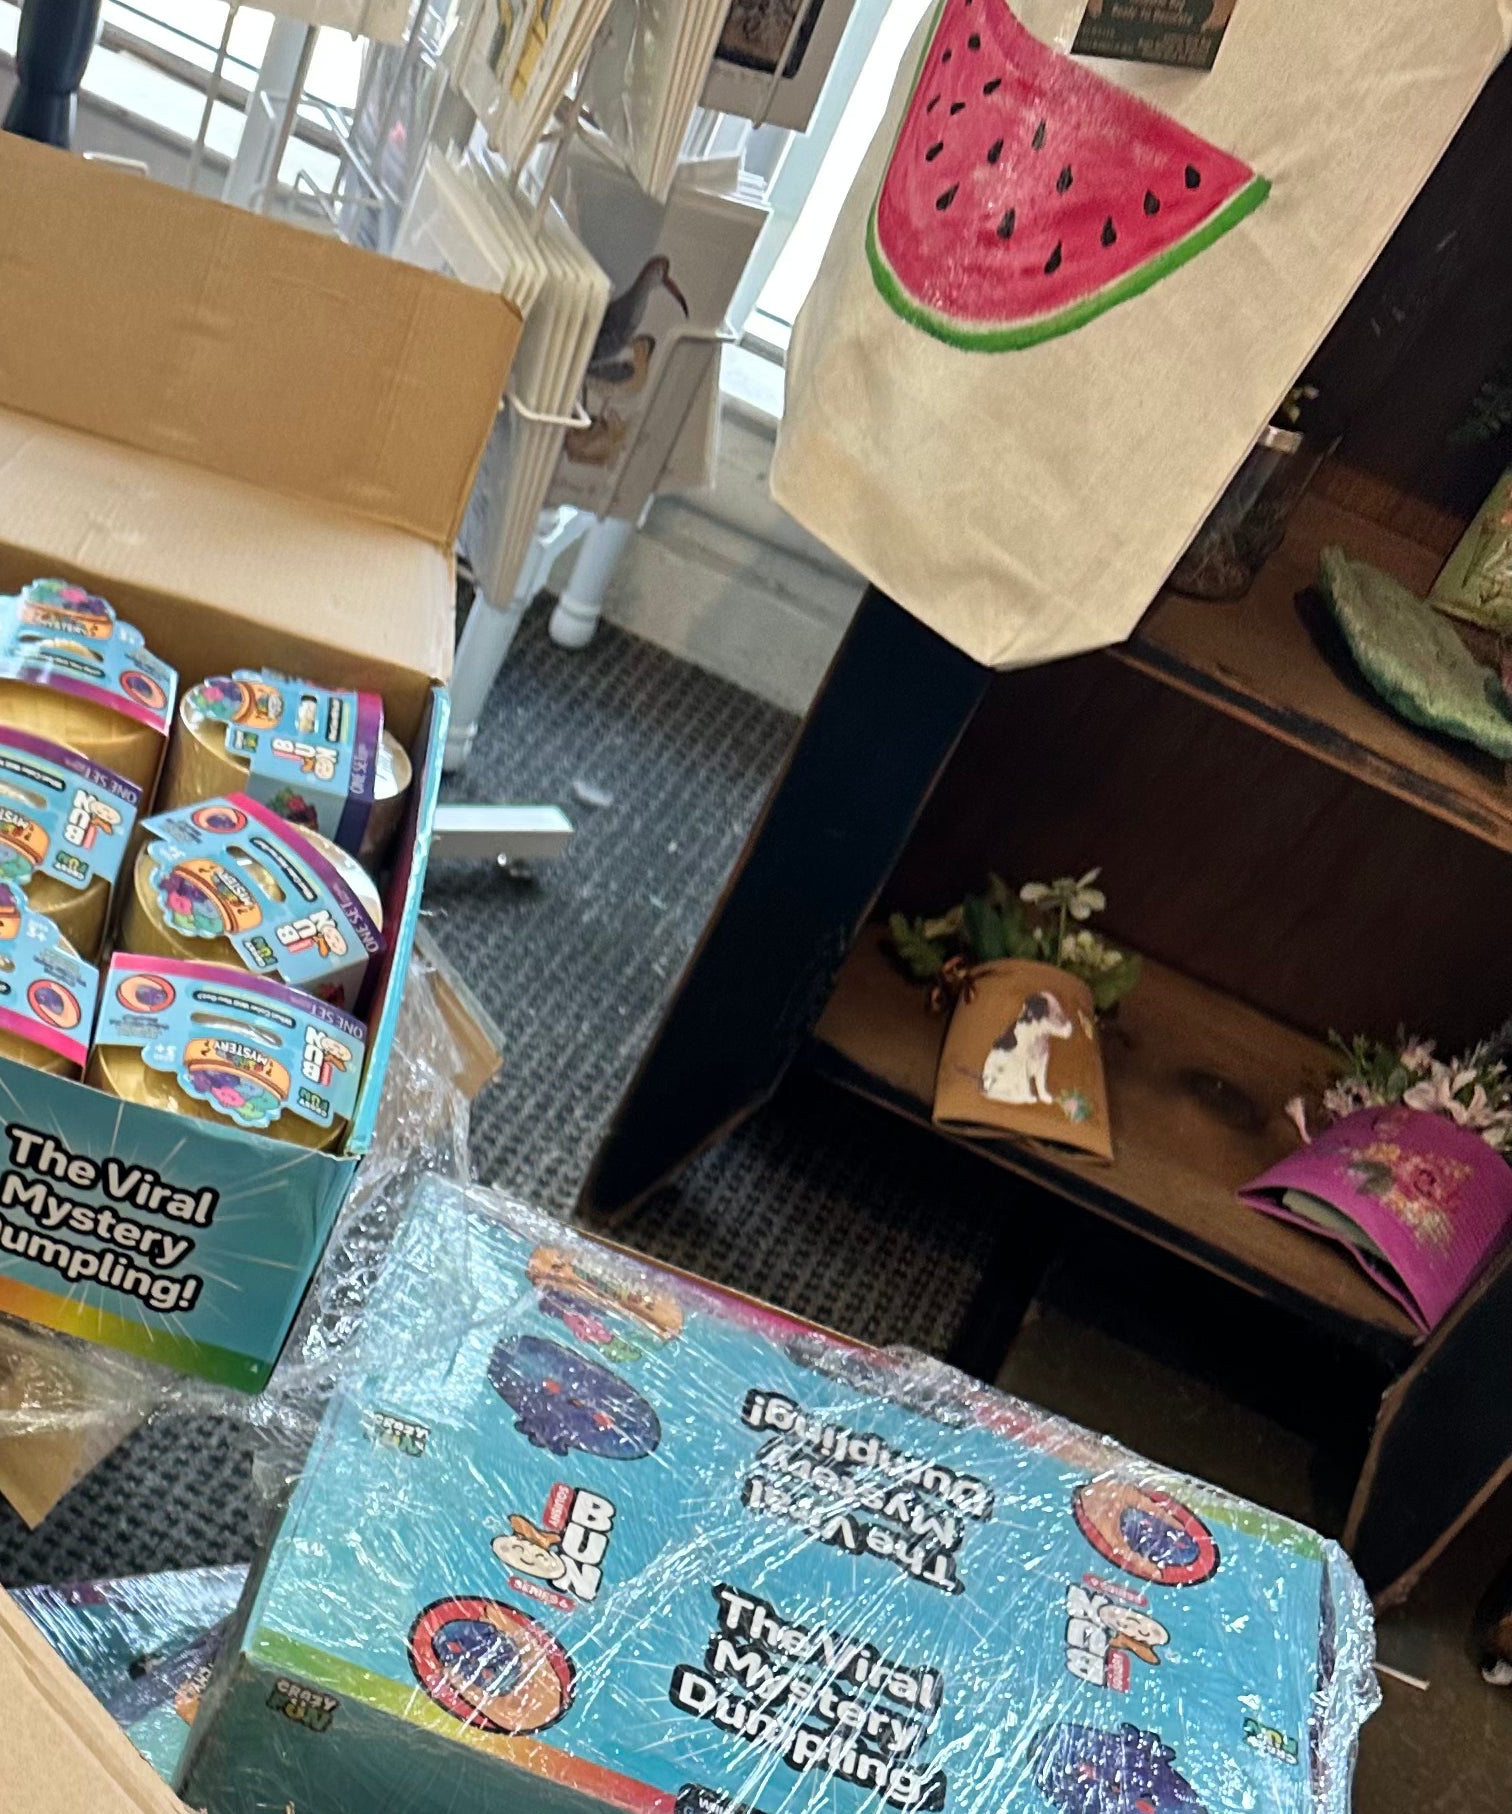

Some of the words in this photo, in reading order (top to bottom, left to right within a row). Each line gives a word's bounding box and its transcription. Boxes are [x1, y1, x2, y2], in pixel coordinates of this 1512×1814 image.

[310, 1005, 336, 1025] SET
[338, 1019, 364, 1040] ONE
[213, 1039, 270, 1066] MYSTERY
[10, 1127, 98, 1185] The
[104, 1162, 214, 1224] Viral
[0, 1173, 190, 1262] Mystery
[552, 1488, 617, 1602] BUN
[719, 1589, 811, 1656] The
